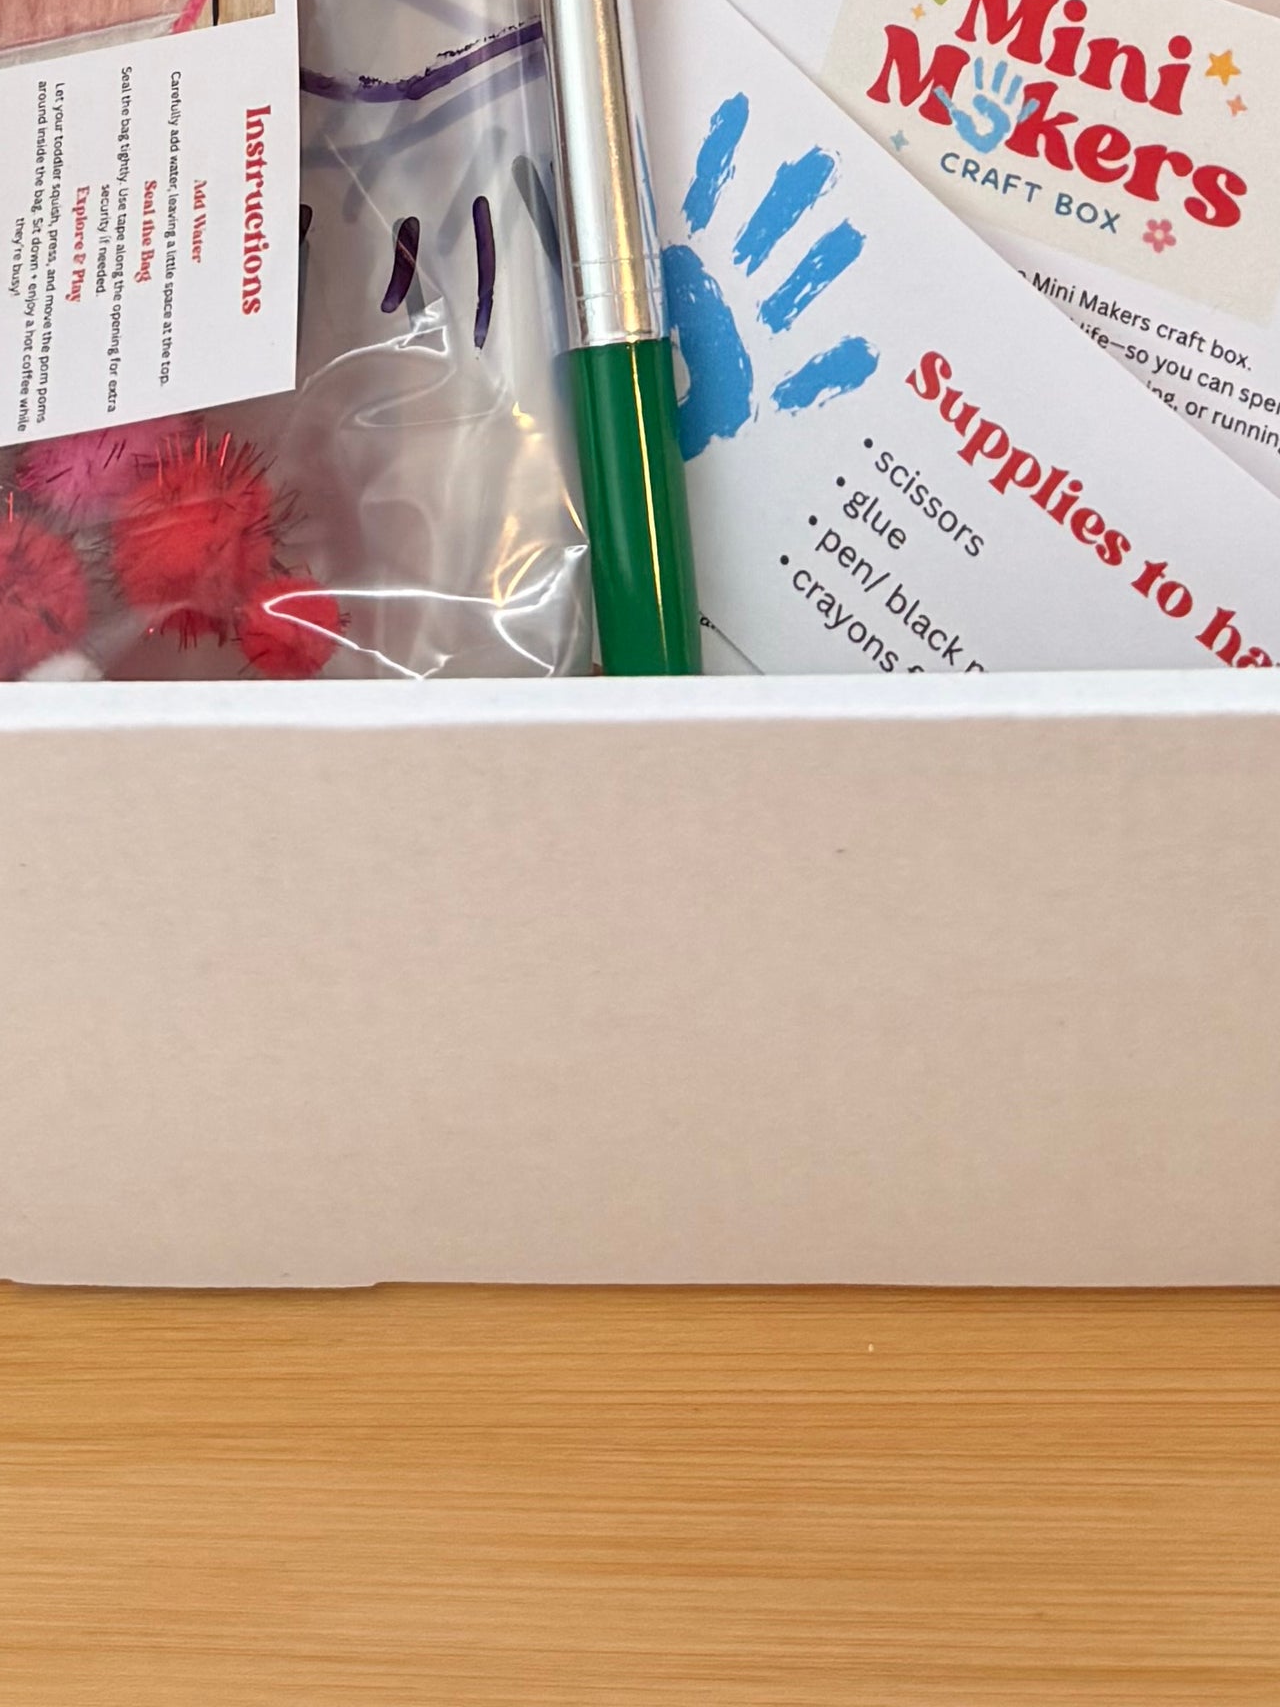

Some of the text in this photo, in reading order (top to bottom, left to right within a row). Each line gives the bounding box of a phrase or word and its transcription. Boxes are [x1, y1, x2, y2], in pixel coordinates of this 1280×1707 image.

[64, 185, 90, 302] Explore & Play
[95, 183, 111, 296] security if needed.
[133, 179, 157, 283] Seal the Bag
[191, 179, 207, 263] Add Water
[241, 104, 271, 315] Instructions
[940, 152, 1120, 234] CRAFT BOX
[1031, 271, 1251, 371] Mini Makers craft box.
[1151, 354, 1193, 381] you
[1196, 372, 1234, 397] can
[1184, 401, 1209, 419] or
[842, 490, 906, 550] glue
[874, 451, 984, 557] scissors
[905, 349, 1132, 567] Supplies
[1130, 560, 1194, 620] to
[792, 569, 899, 673] crayons
[884, 583, 963, 666] black
